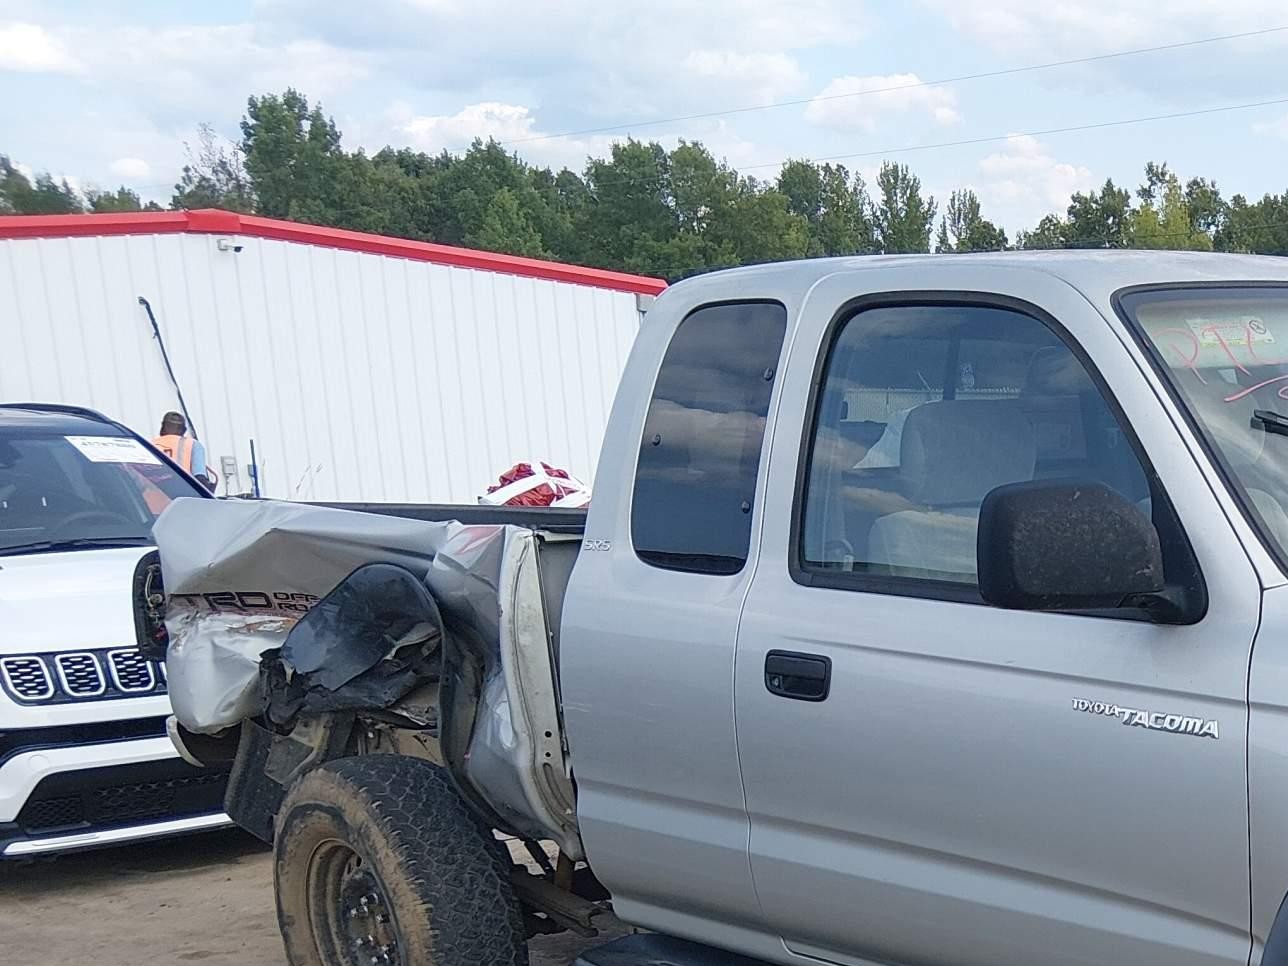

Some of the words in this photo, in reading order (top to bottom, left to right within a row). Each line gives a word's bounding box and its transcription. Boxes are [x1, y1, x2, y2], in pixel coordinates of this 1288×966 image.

[169, 591, 273, 612] TRD
[1072, 698, 1120, 717] TOYOTA
[1119, 708, 1219, 739] TACOMA
